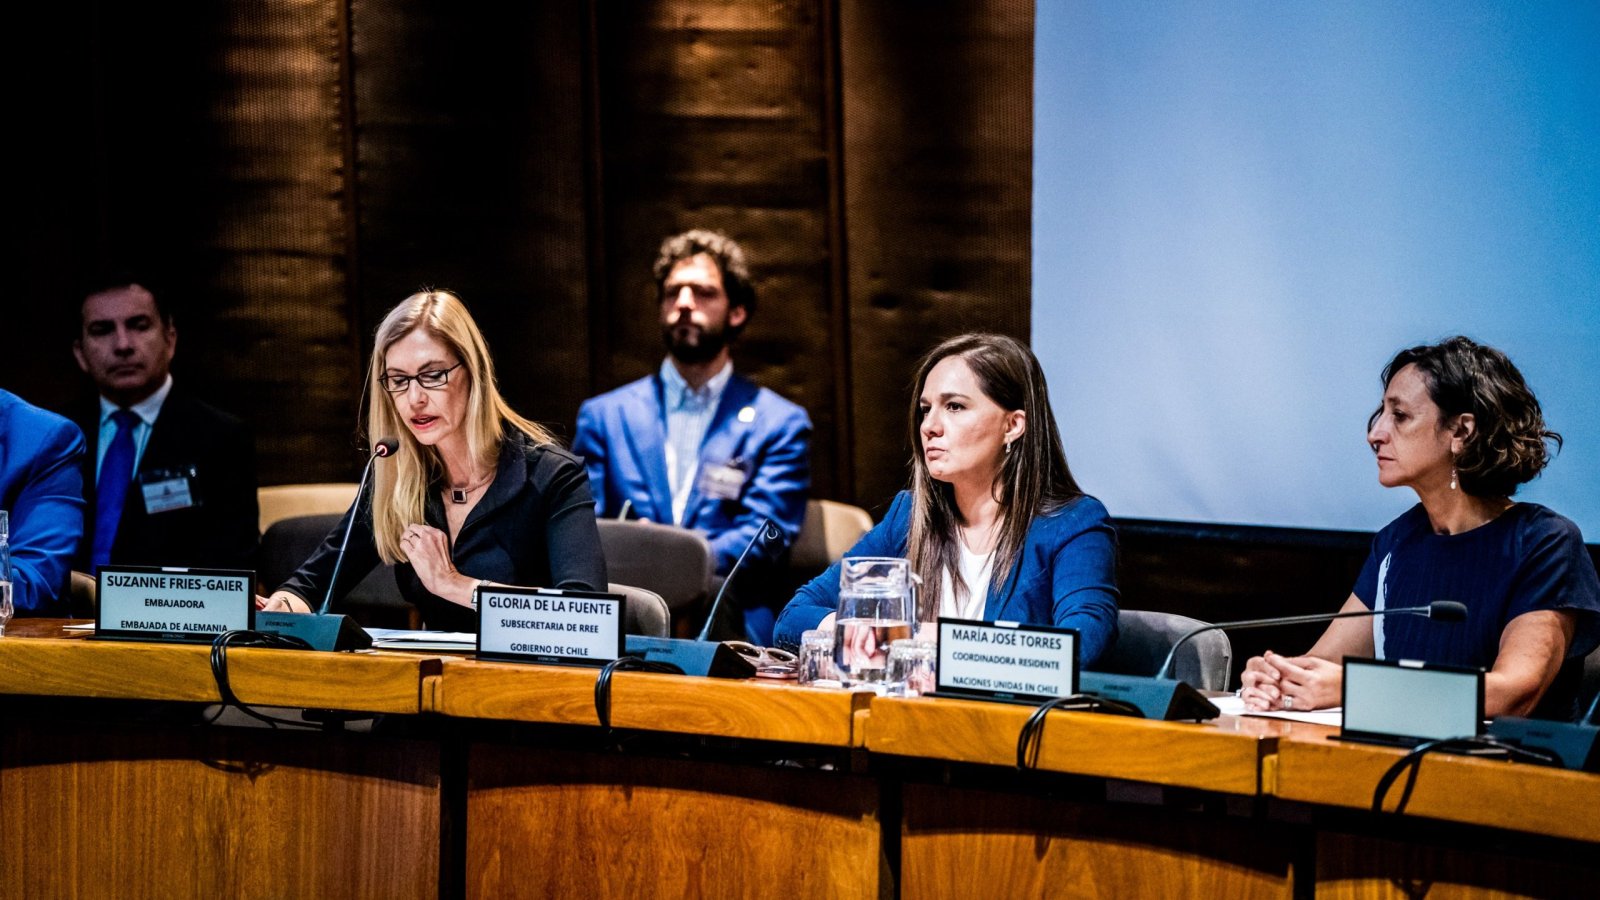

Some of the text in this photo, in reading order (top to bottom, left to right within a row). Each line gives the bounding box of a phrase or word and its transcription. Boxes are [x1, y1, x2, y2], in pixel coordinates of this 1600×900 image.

[107, 575, 244, 592] SUZANNE FRIES-GAIER
[144, 598, 205, 609] EMBAJADORA
[488, 596, 612, 615] GLORIA DE LA FUENTE
[120, 620, 228, 632] EMBAJADA DE ALEMANIA
[500, 619, 599, 633] SUBSECRETARIA DE RREE
[952, 628, 1062, 650] MARÍA JOSÉ TORRES
[510, 643, 588, 656] GOBIERNO DE CHILE
[952, 651, 1060, 670] COORDINADORA RESIDENTE
[952, 676, 1059, 694] NACIONES UNIDAS EN CHILE
